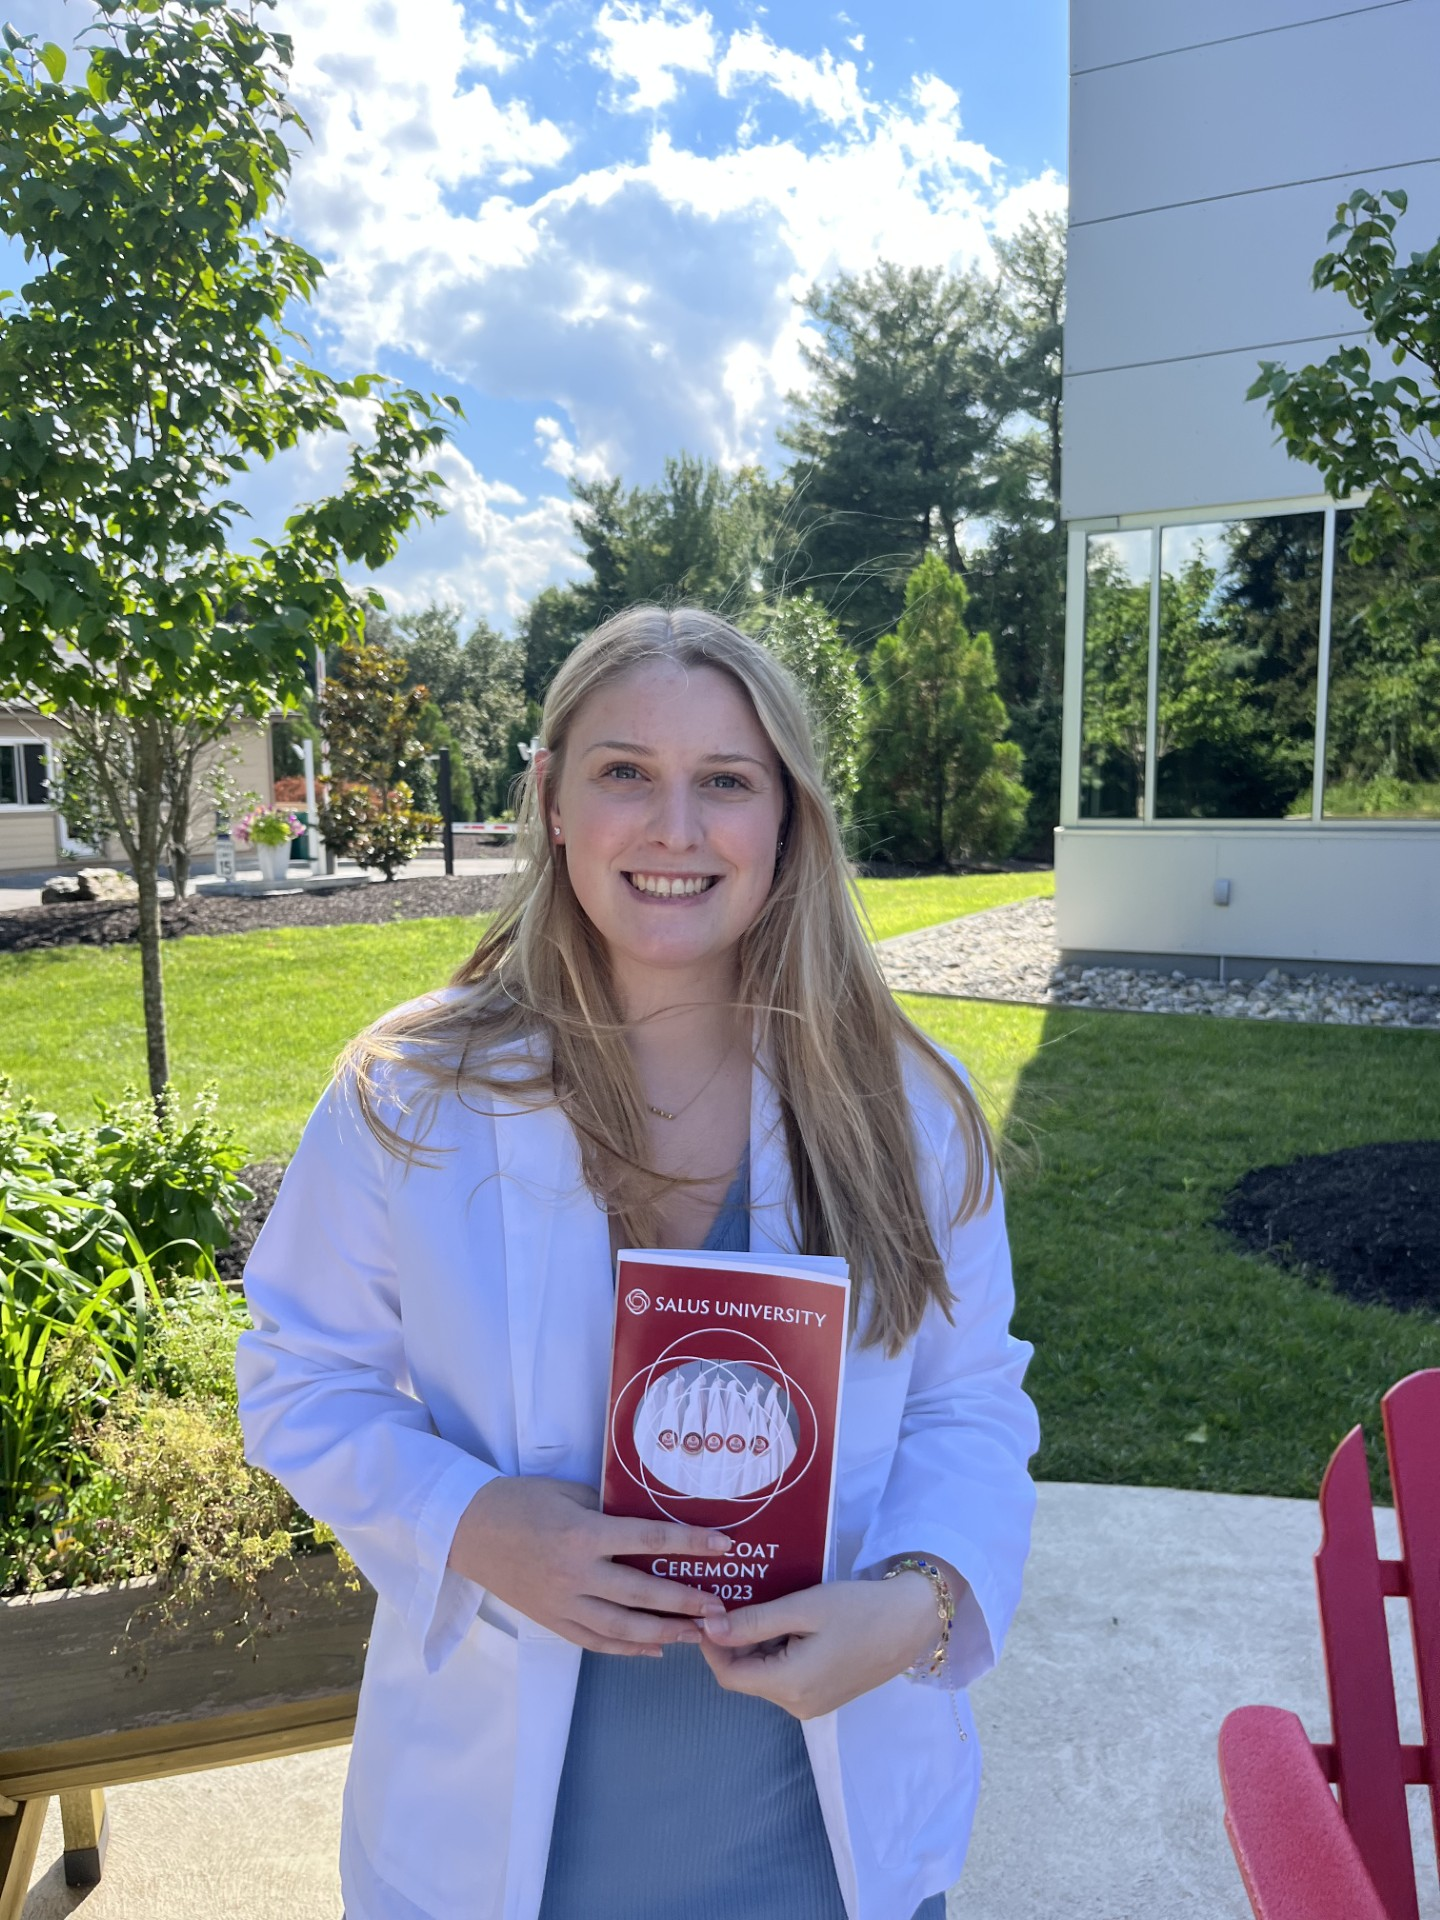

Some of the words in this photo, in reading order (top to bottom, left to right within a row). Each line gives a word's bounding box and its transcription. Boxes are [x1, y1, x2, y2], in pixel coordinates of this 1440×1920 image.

[220, 860, 232, 875] 15
[655, 1296, 710, 1315] SALUS
[715, 1301, 827, 1328] UNIVERSITY
[711, 1584, 753, 1600] 2023
